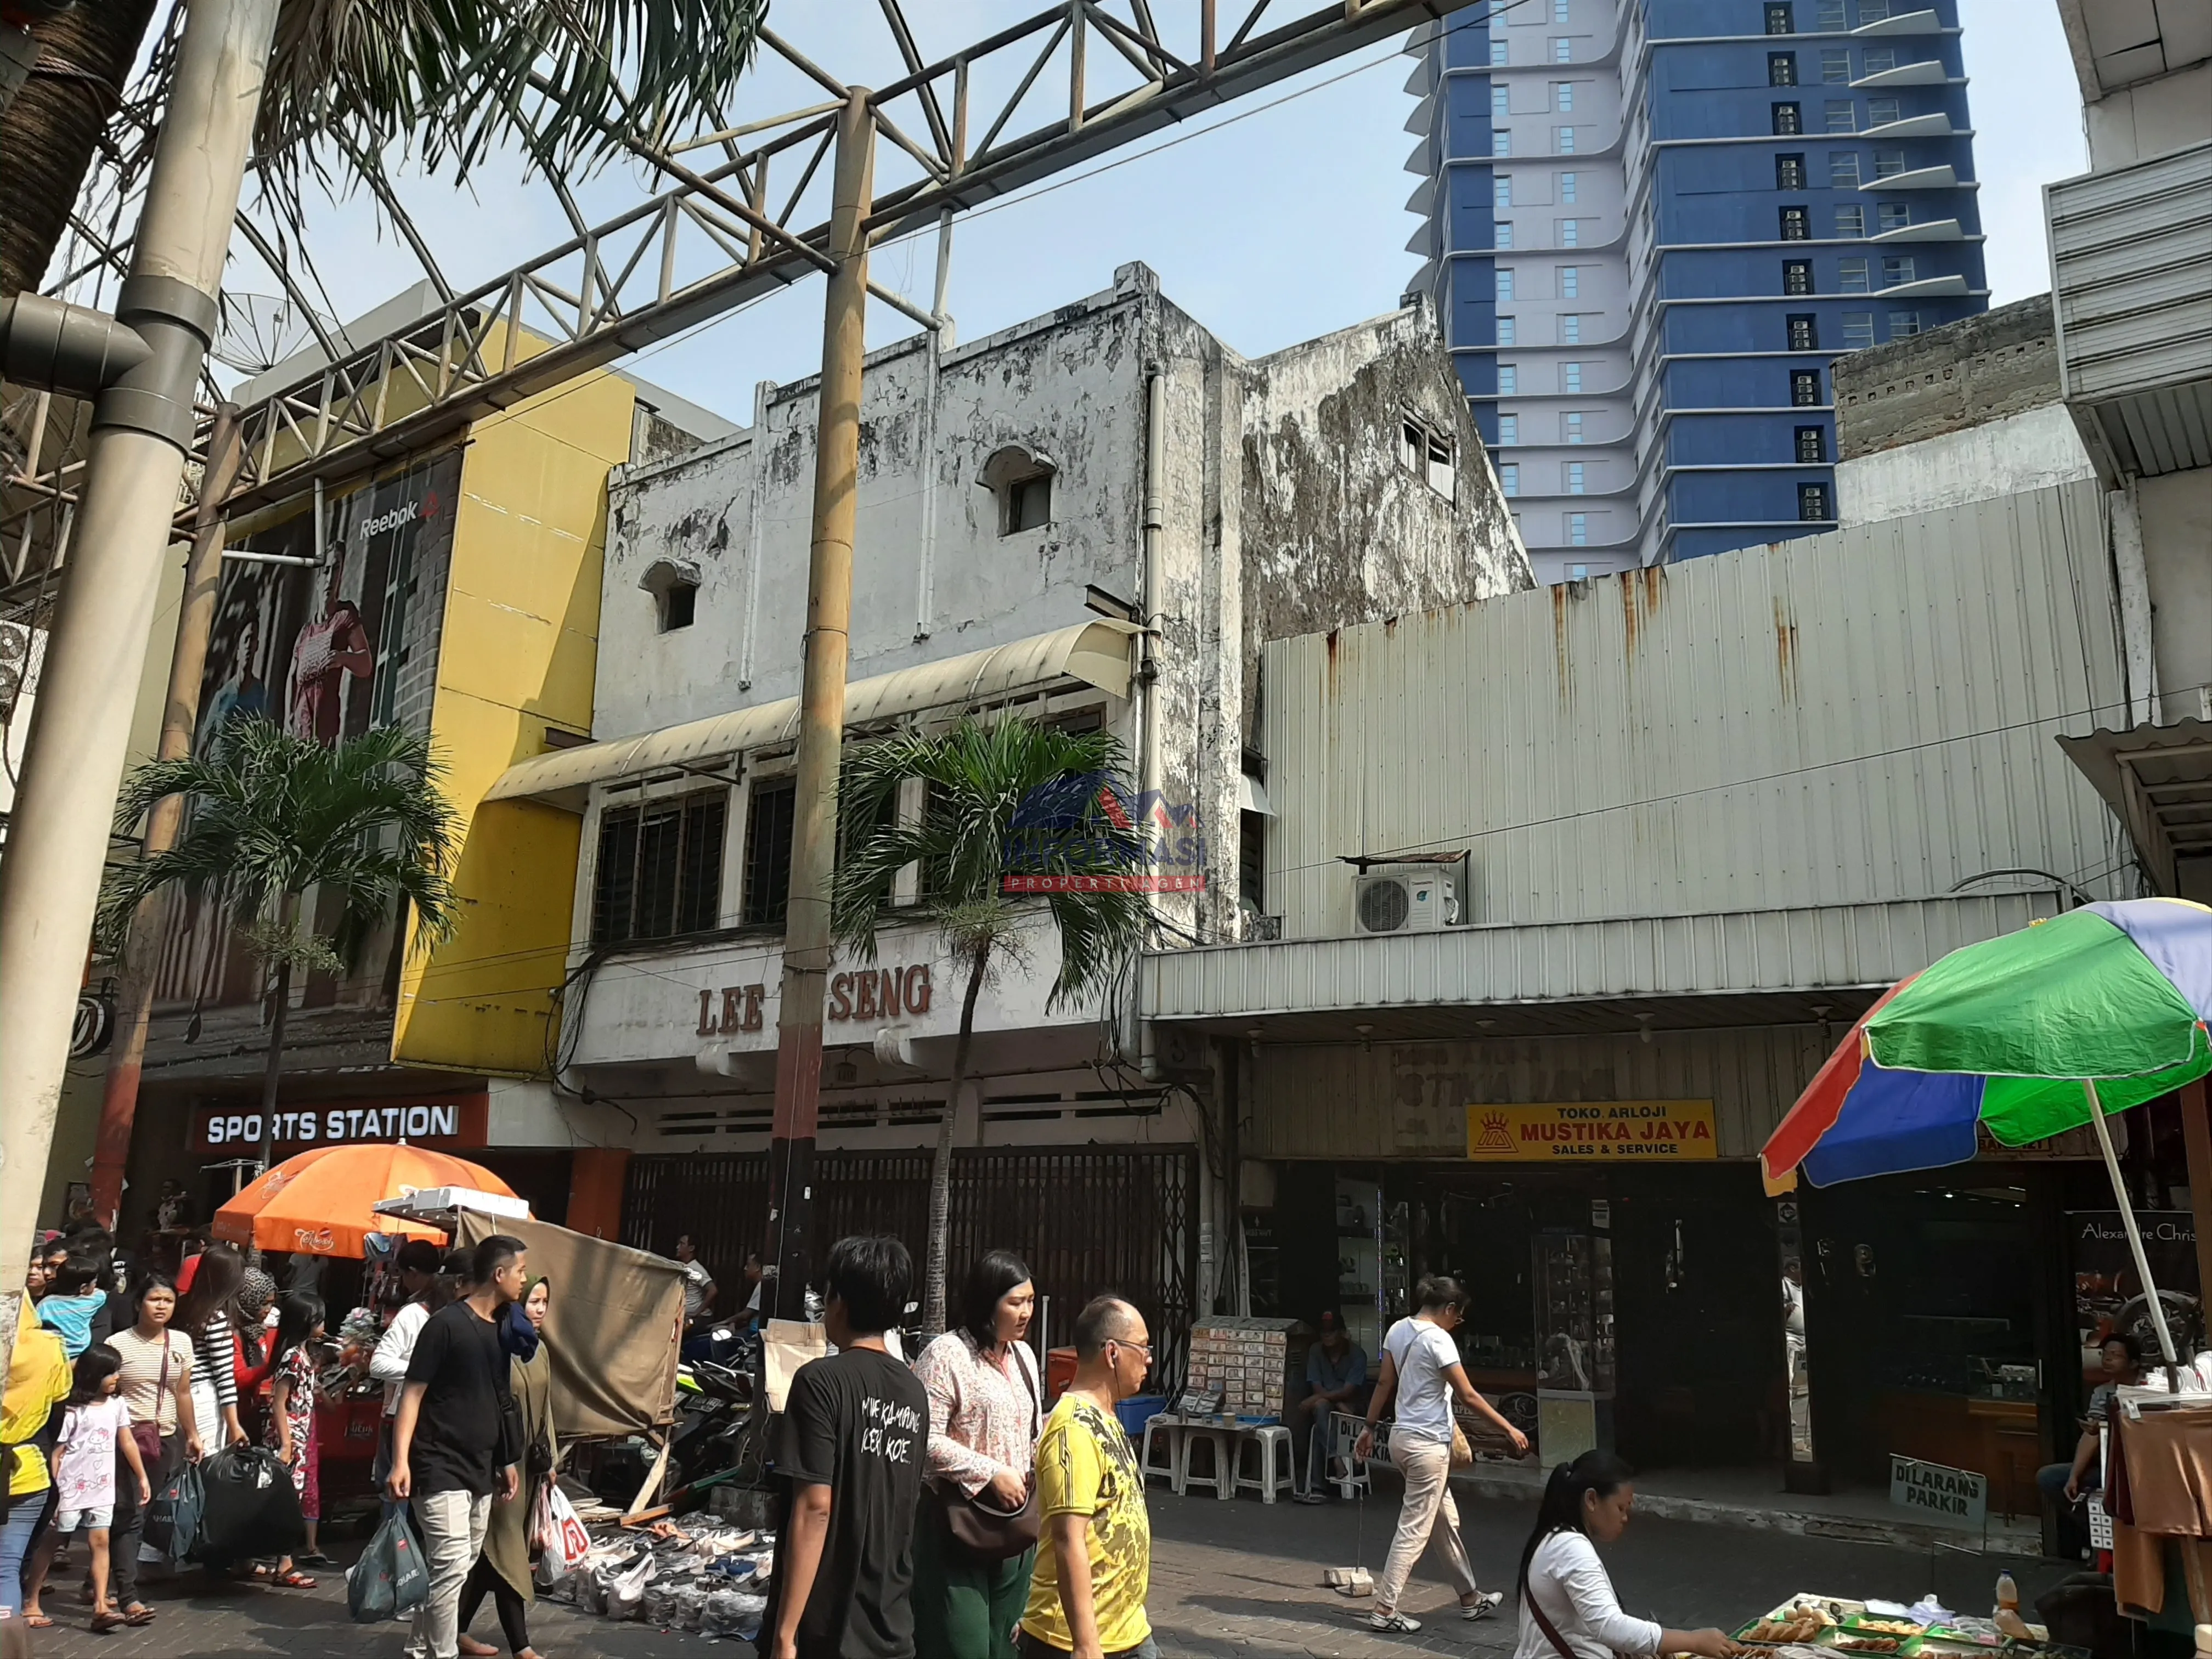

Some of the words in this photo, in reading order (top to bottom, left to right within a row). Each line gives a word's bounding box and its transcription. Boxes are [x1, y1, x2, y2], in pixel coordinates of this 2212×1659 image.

[359, 500, 419, 540] Reebok
[696, 983, 764, 1035] LEE
[828, 963, 932, 1020] SENG
[326, 1105, 455, 1139] STATION
[1609, 1105, 1667, 1119] ARLOJI
[1520, 1122, 1632, 1141] MUSTIKA
[1639, 1120, 1711, 1139] JAYA
[1552, 1144, 1594, 1154] SALES
[1600, 1144, 1610, 1154] &
[1617, 1143, 1678, 1154] SERVICE
[2081, 1223, 2154, 1240] Alexare
